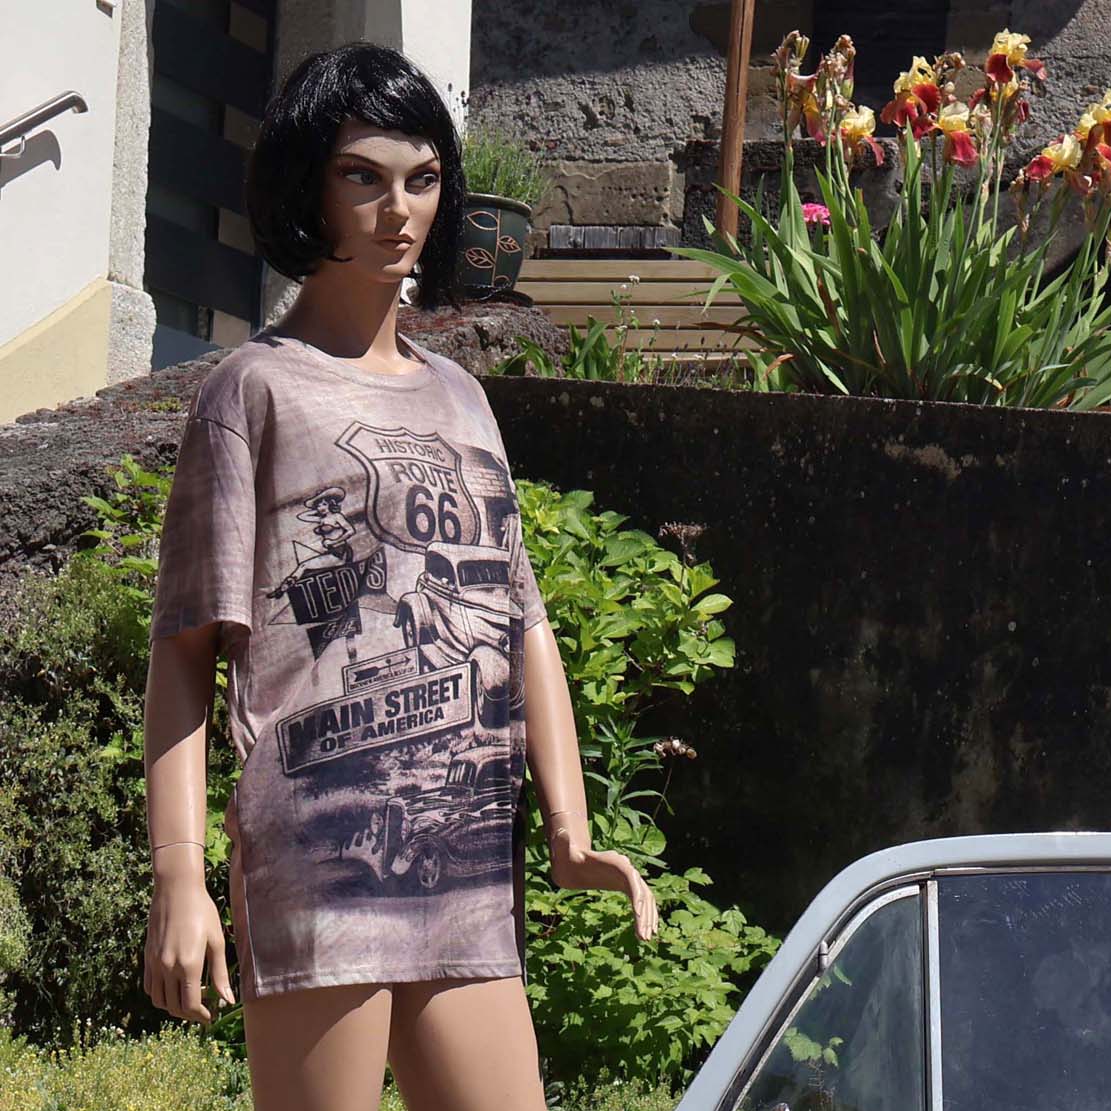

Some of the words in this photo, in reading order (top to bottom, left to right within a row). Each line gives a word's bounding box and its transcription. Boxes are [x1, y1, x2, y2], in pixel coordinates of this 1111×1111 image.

[375, 438, 445, 462] HISTORIC
[389, 460, 459, 494] ROUTE
[405, 484, 461, 545] 66
[297, 552, 386, 619] TED'S
[287, 697, 376, 748] MAIN
[384, 674, 464, 719] STREET
[320, 733, 352, 753] OF
[360, 708, 446, 742] AMERICA
